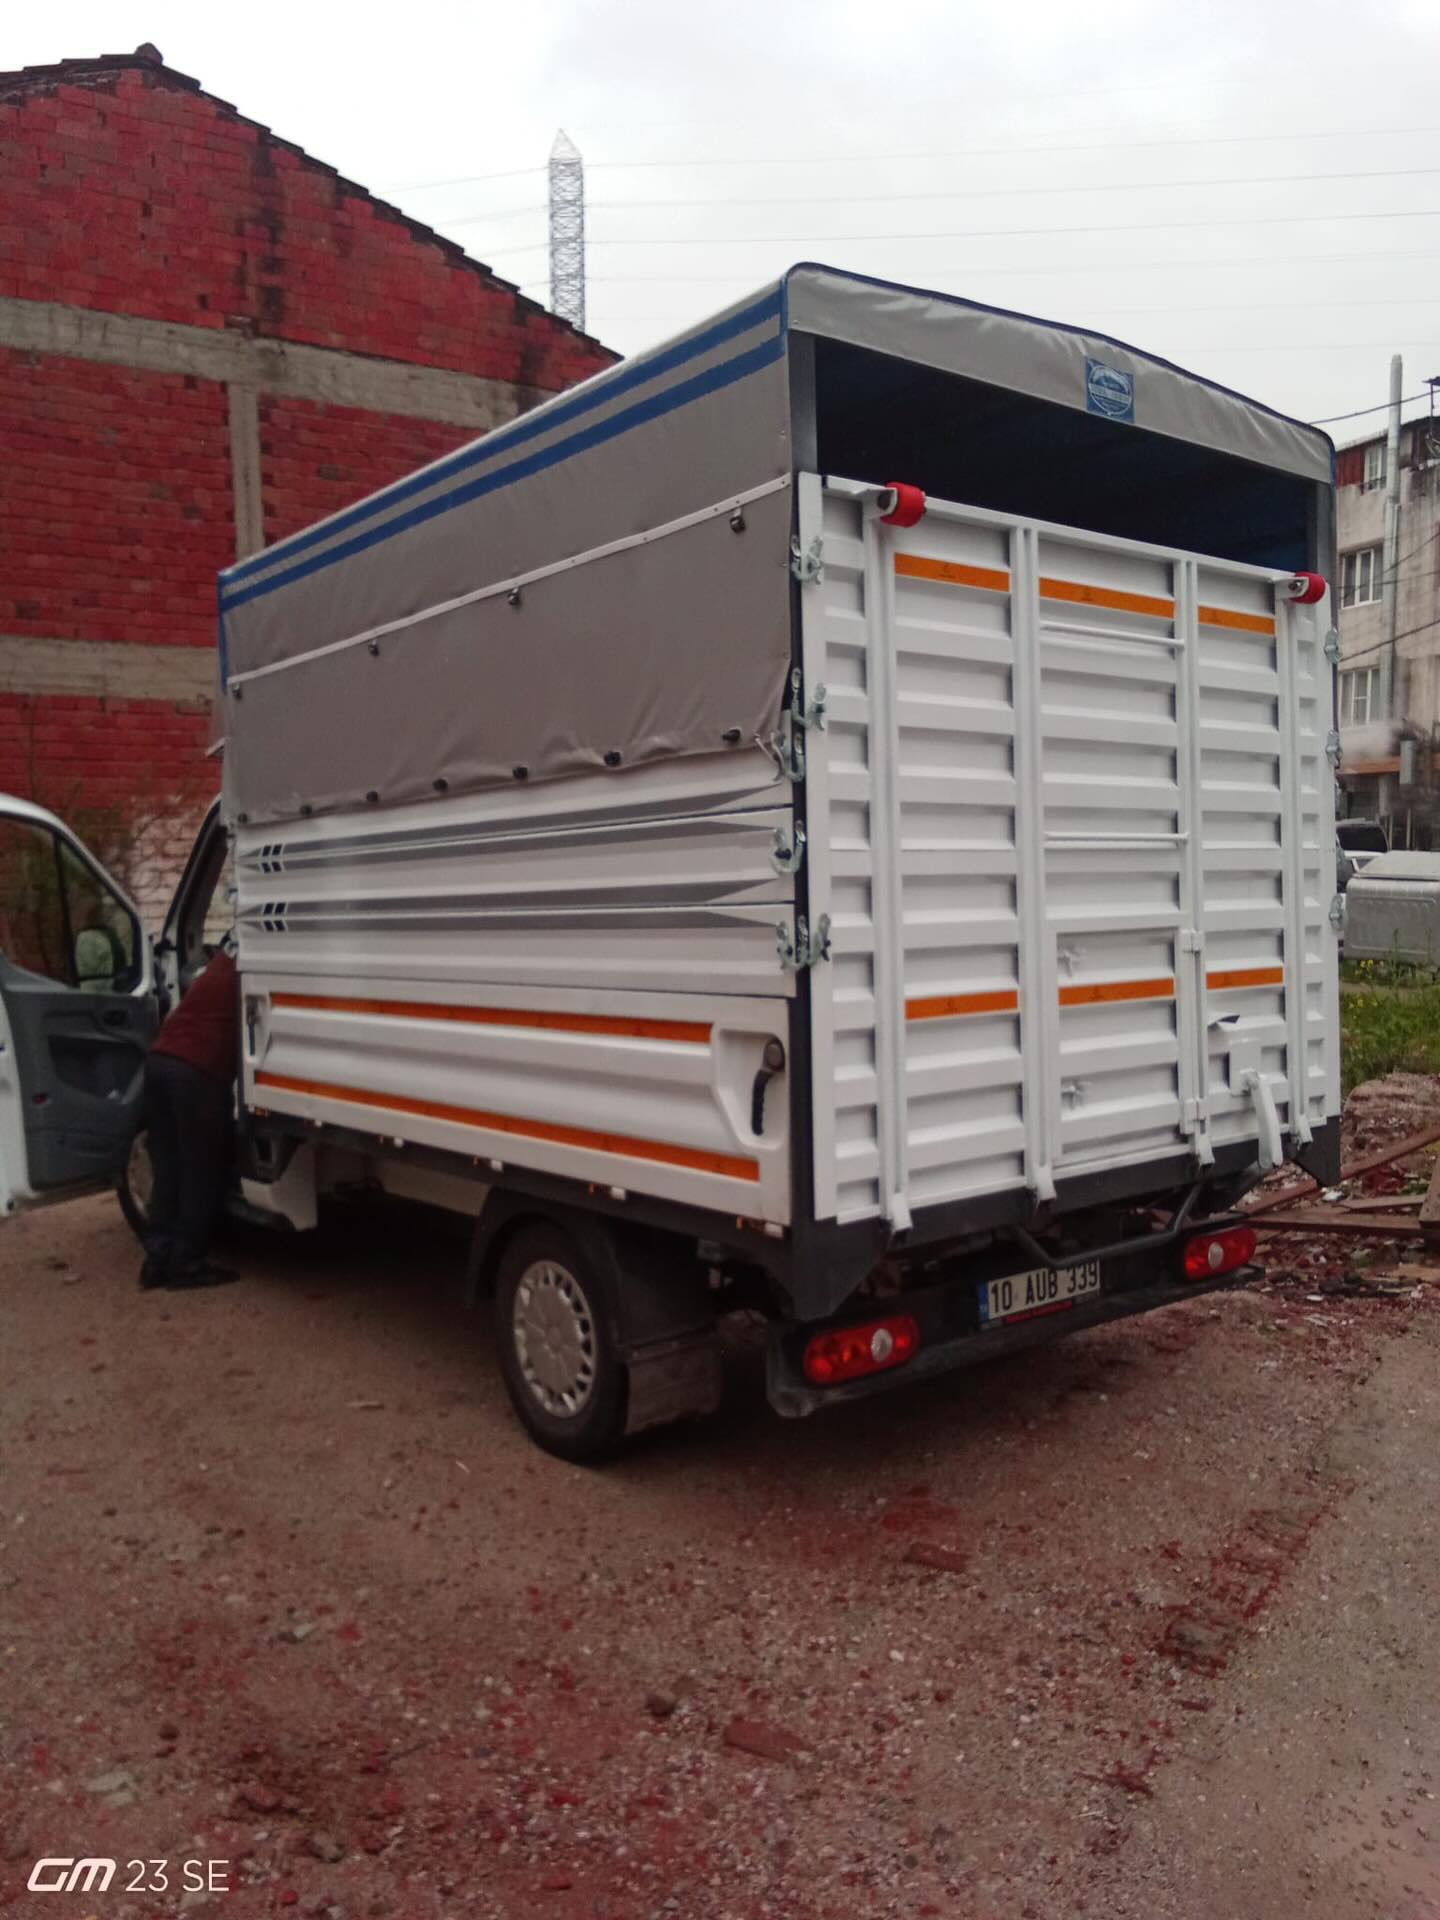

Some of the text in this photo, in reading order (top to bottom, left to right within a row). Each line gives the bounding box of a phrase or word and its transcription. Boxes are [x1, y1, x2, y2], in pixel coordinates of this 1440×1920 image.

[991, 1281, 1012, 1313] 10
[1026, 1269, 1058, 1305] AUB
[1067, 1262, 1098, 1293] 339
